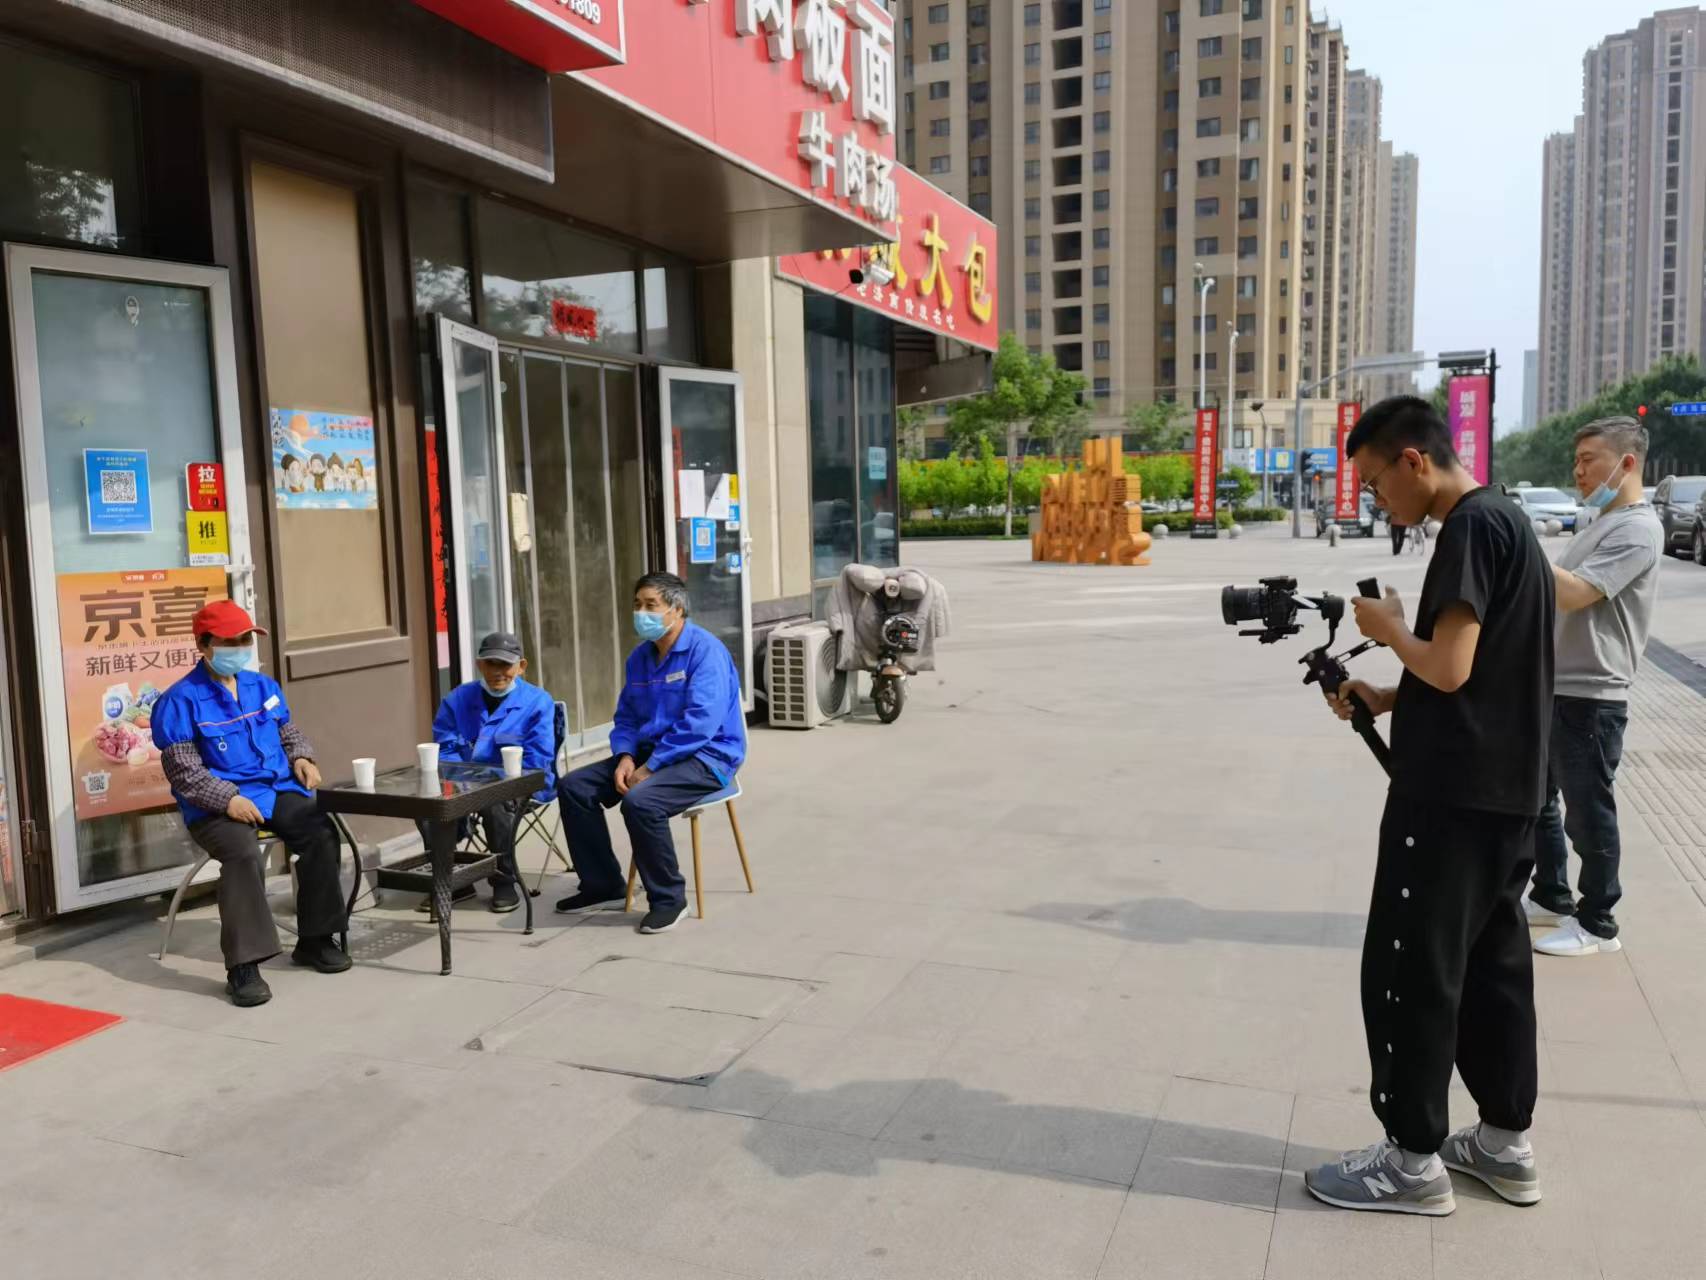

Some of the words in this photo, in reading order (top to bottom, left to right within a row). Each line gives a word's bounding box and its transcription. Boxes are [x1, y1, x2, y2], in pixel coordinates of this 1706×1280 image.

[798, 111, 896, 221] 牛肉汤
[198, 465, 216, 483] 拉
[198, 520, 217, 539] 推
[80, 586, 208, 642] 京喜
[1362, 1171, 1398, 1199] N
